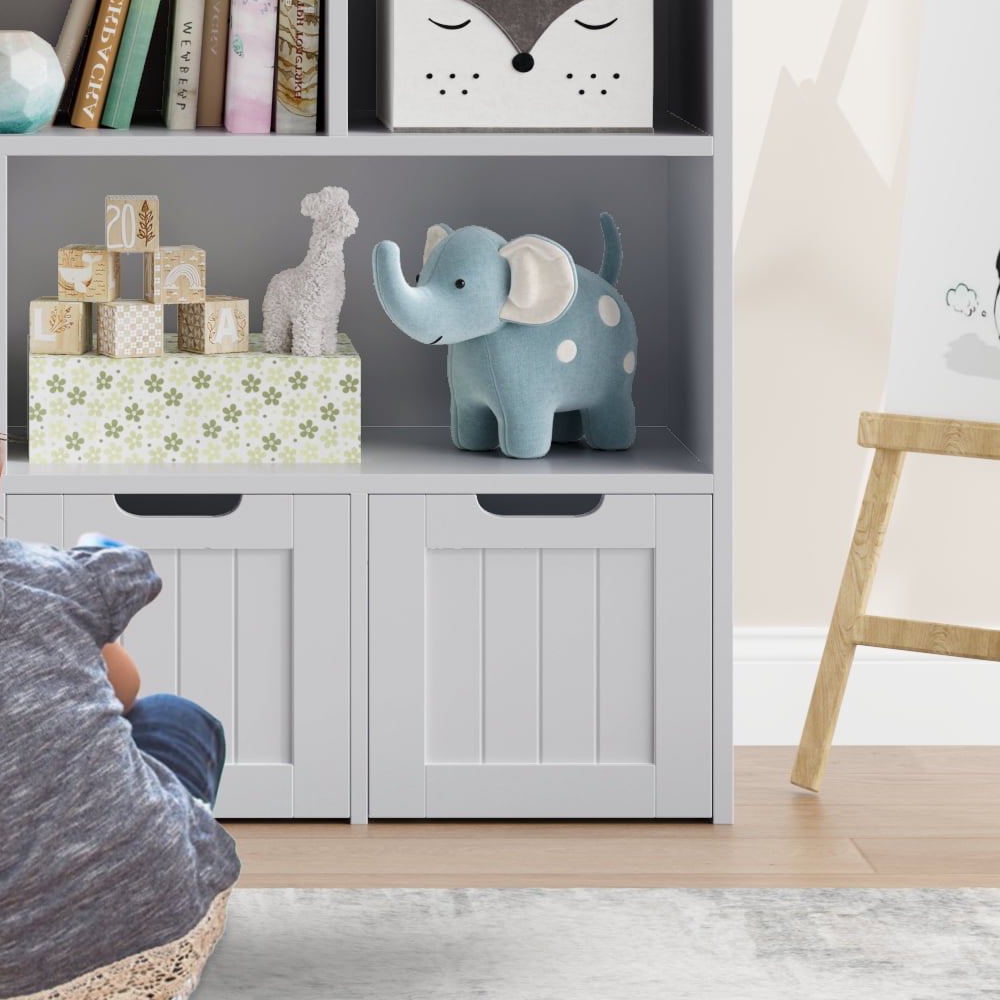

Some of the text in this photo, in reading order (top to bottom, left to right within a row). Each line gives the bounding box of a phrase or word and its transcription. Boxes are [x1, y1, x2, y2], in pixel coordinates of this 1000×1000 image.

[107, 204, 136, 249] 20
[34, 308, 56, 342] L
[215, 308, 240, 344] A
